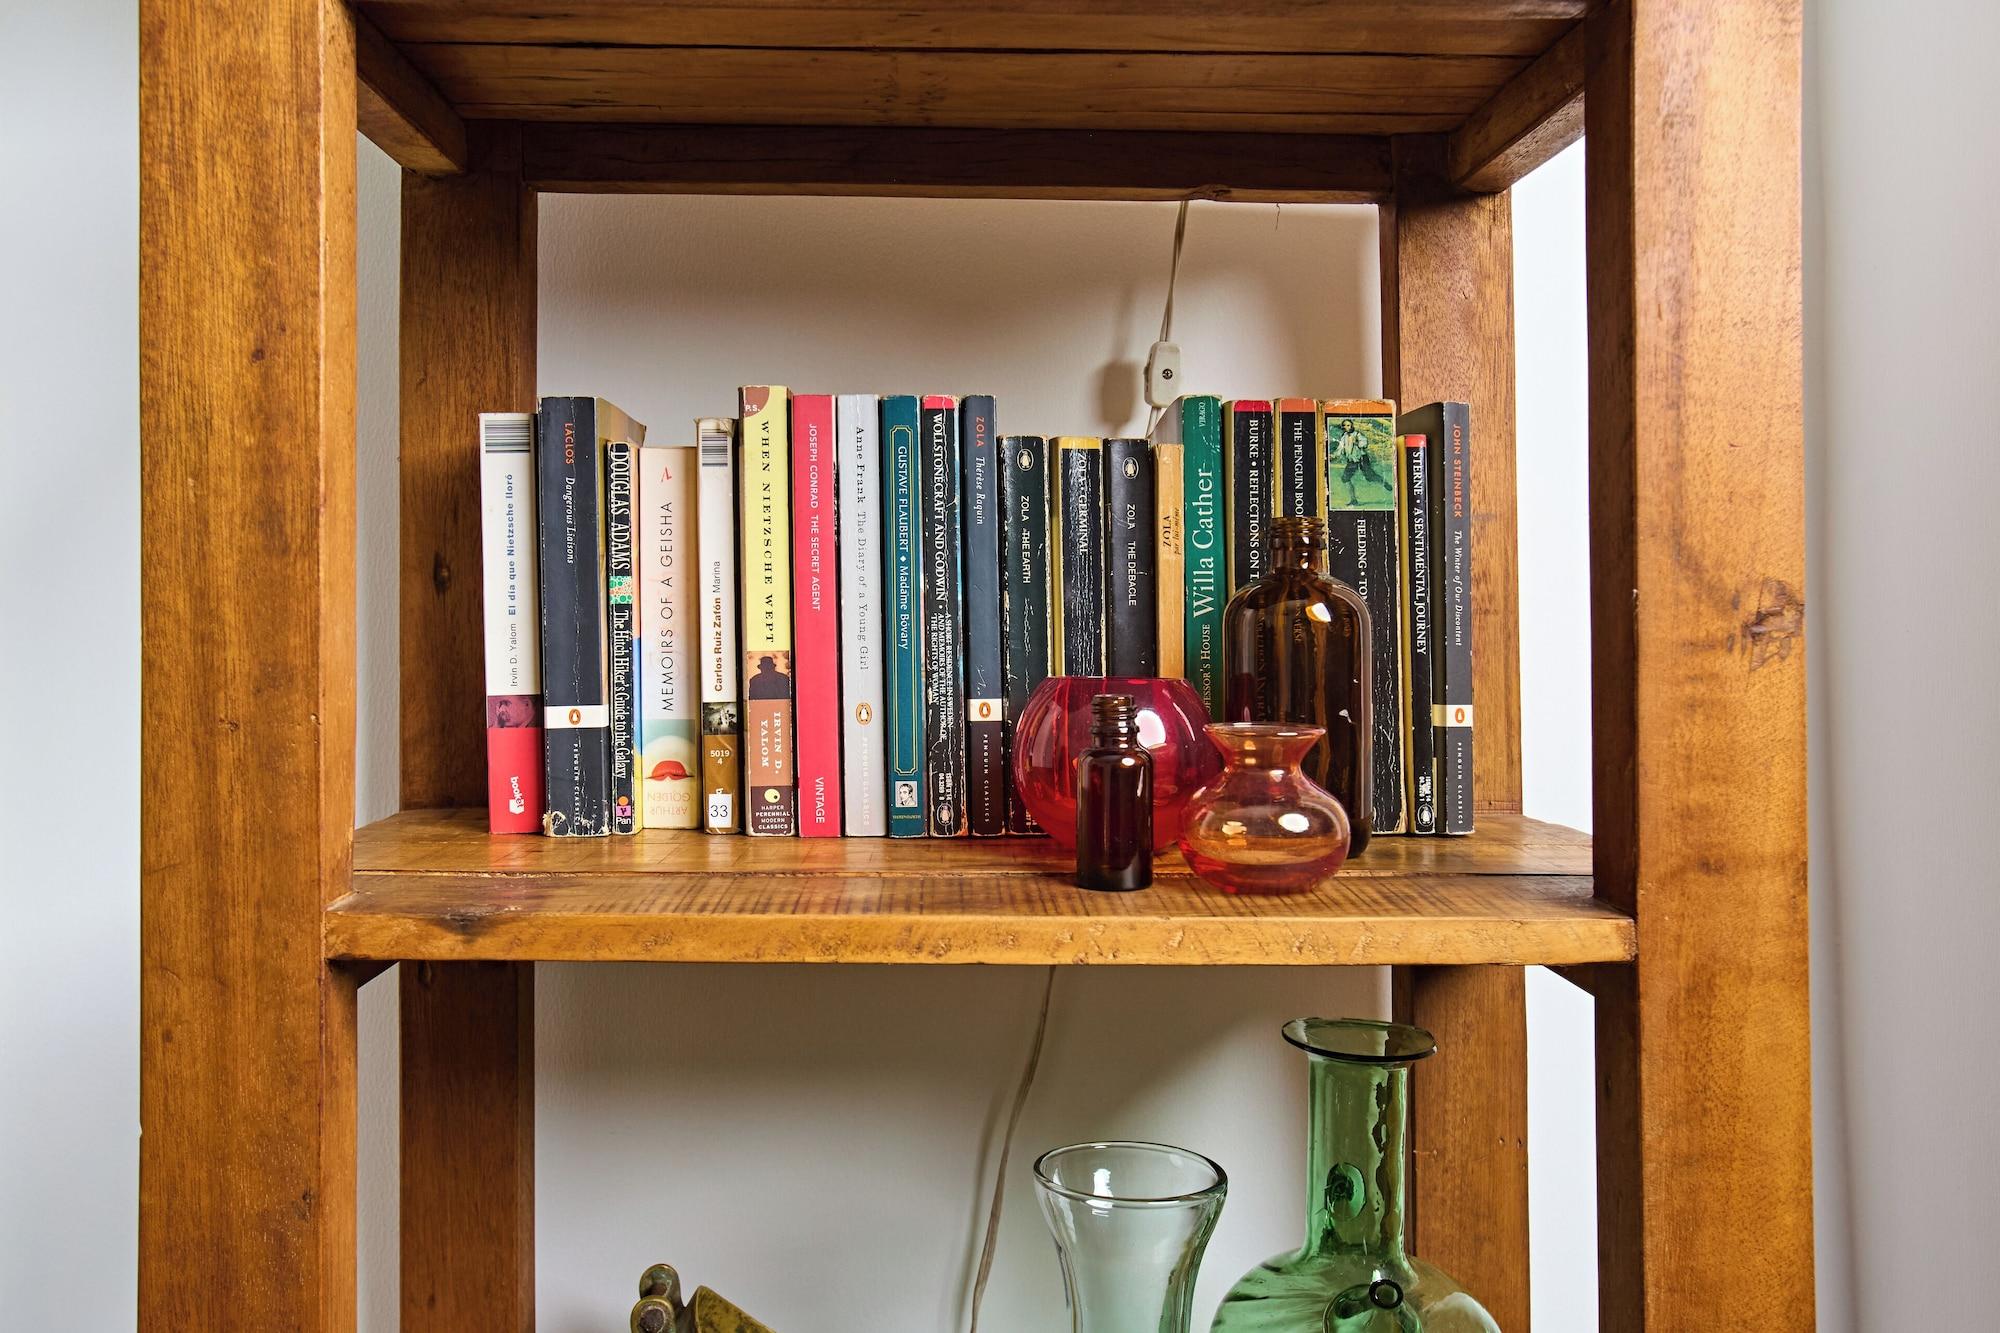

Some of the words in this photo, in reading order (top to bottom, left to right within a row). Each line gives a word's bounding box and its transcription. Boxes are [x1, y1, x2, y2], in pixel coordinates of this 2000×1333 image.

[564, 423, 574, 464] LACLOS
[761, 421, 770, 472] WHEN
[809, 424, 818, 462] JOSEPH
[855, 426, 865, 460] Anne
[976, 416, 984, 447] ZOLA
[1249, 420, 1259, 458] BURKE
[1294, 420, 1302, 441] THE
[1453, 424, 1461, 454] JOHN
[898, 446, 907, 494] GUSTAVE
[933, 414, 945, 522] WOLLSTONECRAFT
[976, 456, 986, 490] Thérèse
[1078, 454, 1087, 481] ZOLA
[1294, 444, 1303, 489] PENGUIN
[1412, 452, 1423, 496] STERNE
[505, 474, 514, 498] lloró
[610, 452, 630, 516] DOUGLAS
[810, 465, 819, 509] CONRAD
[857, 464, 866, 503] Frank
[1454, 459, 1462, 518] STEINBECK
[563, 477, 576, 524] Dangerous
[974, 493, 985, 525] Raquin
[1021, 496, 1030, 521] ZOLA
[1127, 504, 1135, 529] ZOLA
[1192, 468, 1214, 549] Cather
[1249, 470, 1259, 547] REFLECTIONS
[1414, 507, 1423, 516] A
[506, 504, 515, 556] Nietzsche
[660, 502, 672, 567] GEISHA
[762, 482, 773, 585] NIETZSCHE
[811, 515, 819, 534] THE
[857, 512, 866, 534] The
[899, 498, 908, 552] FLAUBERT
[934, 524, 945, 550] AND
[1079, 495, 1088, 555] GERMINAL
[1162, 515, 1172, 547] ZOLA
[1454, 530, 1462, 544] The
[566, 526, 576, 564] Liaisons
[610, 522, 630, 570] ADAMS
[811, 537, 820, 574] SECRET
[856, 538, 867, 572] Diary
[1022, 531, 1030, 549] THE
[1128, 541, 1136, 559] THE
[1357, 519, 1366, 569] FIELDING
[508, 561, 516, 580] que
[1022, 552, 1031, 583] EARTH
[1250, 550, 1260, 569] ON
[1414, 518, 1424, 600] SENTIMENTAL
[1454, 548, 1462, 573] Winter
[661, 576, 672, 588] A
[712, 561, 721, 593] Marina
[858, 576, 867, 587] of
[900, 566, 909, 610] Madame
[934, 552, 946, 601] GODWIN
[1128, 562, 1136, 606] DEBACLE
[1192, 556, 1215, 618] Willa
[1453, 576, 1462, 586] of
[508, 605, 516, 616] El
[660, 597, 673, 620] OF
[812, 576, 820, 612] AGENT
[614, 611, 630, 629] The
[712, 598, 722, 628] Zafón
[765, 594, 774, 644] WEPT
[858, 604, 868, 642] Young
[1414, 601, 1426, 655] JOURNEY
[509, 624, 517, 650] Yalom
[614, 630, 631, 656] Hitch
[714, 631, 722, 654] Ruiz
[898, 614, 909, 650] Bovary
[1200, 624, 1210, 659] HOUSE
[510, 654, 518, 664] D.
[661, 629, 673, 712] MEMOIRS
[714, 657, 723, 692] Carlos
[859, 646, 869, 670] Girl
[932, 660, 939, 672] OF
[939, 668, 945, 679] OF
[510, 668, 518, 686] Irvin
[615, 658, 630, 692] Hiker's
[946, 686, 953, 695] IN
[615, 692, 630, 720] Guide
[615, 731, 630, 748] the
[616, 720, 628, 731] to
[774, 712, 782, 753] IRVIN
[760, 720, 769, 768] YALOM
[614, 748, 630, 779] Galaxy
[774, 760, 783, 774] D.
[710, 805, 728, 818] 33
[815, 777, 825, 824] VINTAGE
[616, 816, 632, 825] Pan
